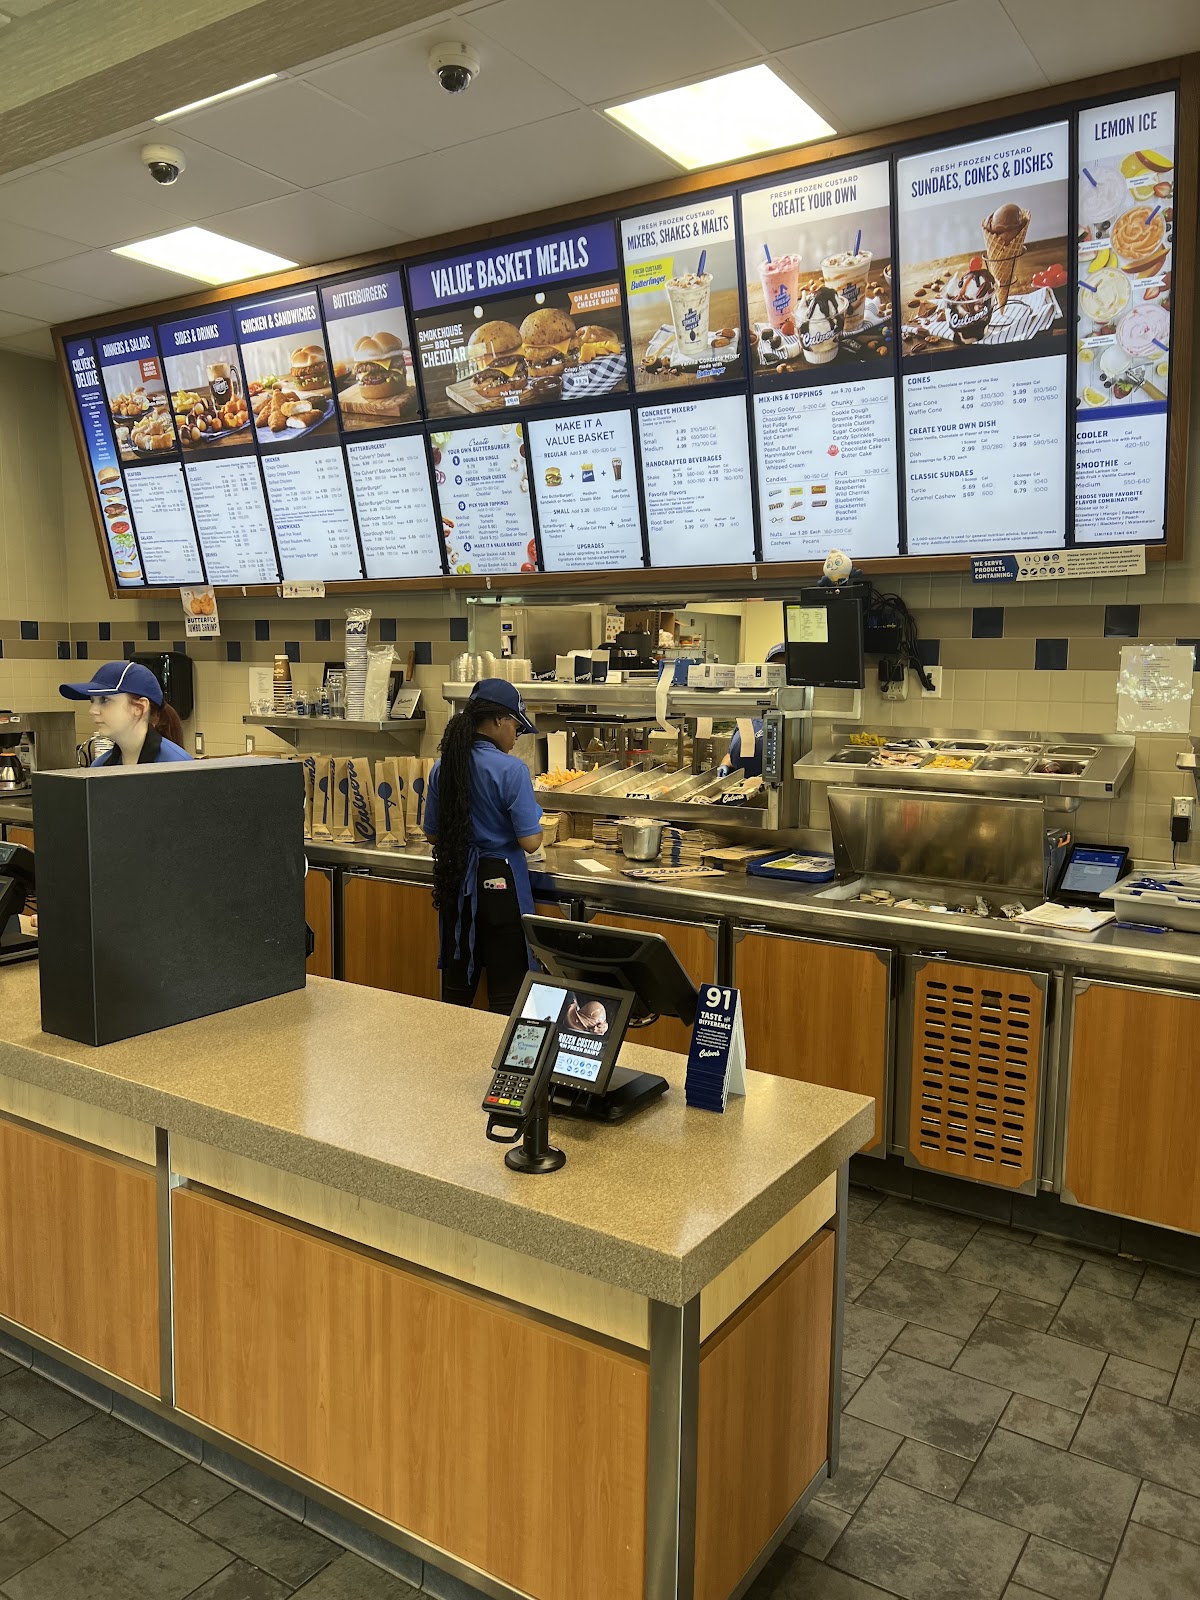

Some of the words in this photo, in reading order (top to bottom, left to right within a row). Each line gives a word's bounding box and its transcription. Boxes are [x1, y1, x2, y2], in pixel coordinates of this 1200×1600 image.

[1094, 118, 1135, 141] LEMON
[1138, 111, 1158, 132] ICE
[930, 162, 956, 174] FRESH
[958, 155, 991, 169] FROZEN
[993, 146, 1033, 161] CUSTARD
[911, 174, 962, 198] SUNDAES,
[964, 165, 999, 187] CONES
[1002, 161, 1011, 178] &
[1013, 151, 1054, 177] DISHES
[770, 189, 792, 200] FRESH
[794, 183, 823, 194] FROZEN
[824, 174, 859, 188] CUSTARD
[772, 196, 805, 218] CREATE
[808, 191, 832, 209] YOUR
[834, 185, 857, 204] OWN
[638, 223, 658, 231] FRESH
[659, 217, 684, 227] FROZEN
[685, 209, 715, 221] CUSTARD
[627, 230, 659, 250] MIXERS,
[660, 223, 691, 244] SHAKES
[693, 223, 700, 236] &
[701, 215, 729, 234] MALTS
[431, 262, 475, 298] VALUE
[476, 249, 533, 289] BASKET
[536, 236, 589, 277] MEALS
[633, 266, 645, 275] FRESH
[645, 264, 662, 273] CUSTARD
[630, 275, 666, 291] Butterfinger
[574, 295, 583, 303] ON
[590, 288, 619, 300] CHEDDAR
[577, 299, 600, 309] CHEESE
[601, 295, 617, 305] BUN!
[241, 317, 268, 334] CHICKEN
[268, 315, 274, 329] &
[274, 305, 316, 328] SANDWICHES
[174, 331, 190, 345] SIDES
[191, 329, 197, 343] &
[197, 324, 219, 341] DRINKS
[418, 324, 463, 342] SMOKEHOUSE
[102, 340, 126, 357] DINNERS
[125, 339, 130, 353] &
[130, 336, 151, 351] SALADS
[434, 340, 450, 349] BBQ
[72, 356, 96, 372] CULVER'S
[421, 346, 466, 368] CHEDDAR
[699, 356, 724, 365] Concrete
[724, 353, 741, 361] Mixer
[75, 370, 100, 389] DELUXE
[907, 376, 931, 385] CONES
[758, 395, 783, 403] MIX-INS
[791, 390, 823, 399] TOPPINGS
[831, 399, 854, 407] Chunky
[555, 420, 582, 432] MAKE
[584, 419, 593, 429] IT
[595, 418, 603, 428] A
[909, 426, 936, 435] CREATE
[937, 423, 957, 432] YOUR
[958, 421, 977, 430] OWN
[979, 420, 997, 428] DISH
[468, 438, 489, 447] Create
[545, 434, 576, 447] VALUE
[578, 430, 615, 443] BASKET
[1077, 430, 1108, 440] COOLER
[472, 443, 510, 452] BUTTERBURGER
[645, 458, 687, 468] HANDCRAFTED
[688, 455, 722, 464] BEVERAGES
[1077, 459, 1119, 470] SMOOTHIE
[910, 472, 938, 481] CLASSIC
[940, 469, 974, 478] SUNDAES
[975, 572, 1013, 580] CONTAINING:
[187, 624, 201, 632] JUMBO
[202, 623, 217, 632] SHRIMP
[705, 987, 732, 1011] 91
[698, 1018, 732, 1030] DIFFERENCE
[700, 1011, 723, 1022] TASTE
[558, 1033, 576, 1047] ROZEN
[576, 1037, 603, 1051] CUSTARD
[567, 1044, 584, 1053] FRESH
[584, 1048, 600, 1057] DAIRY
